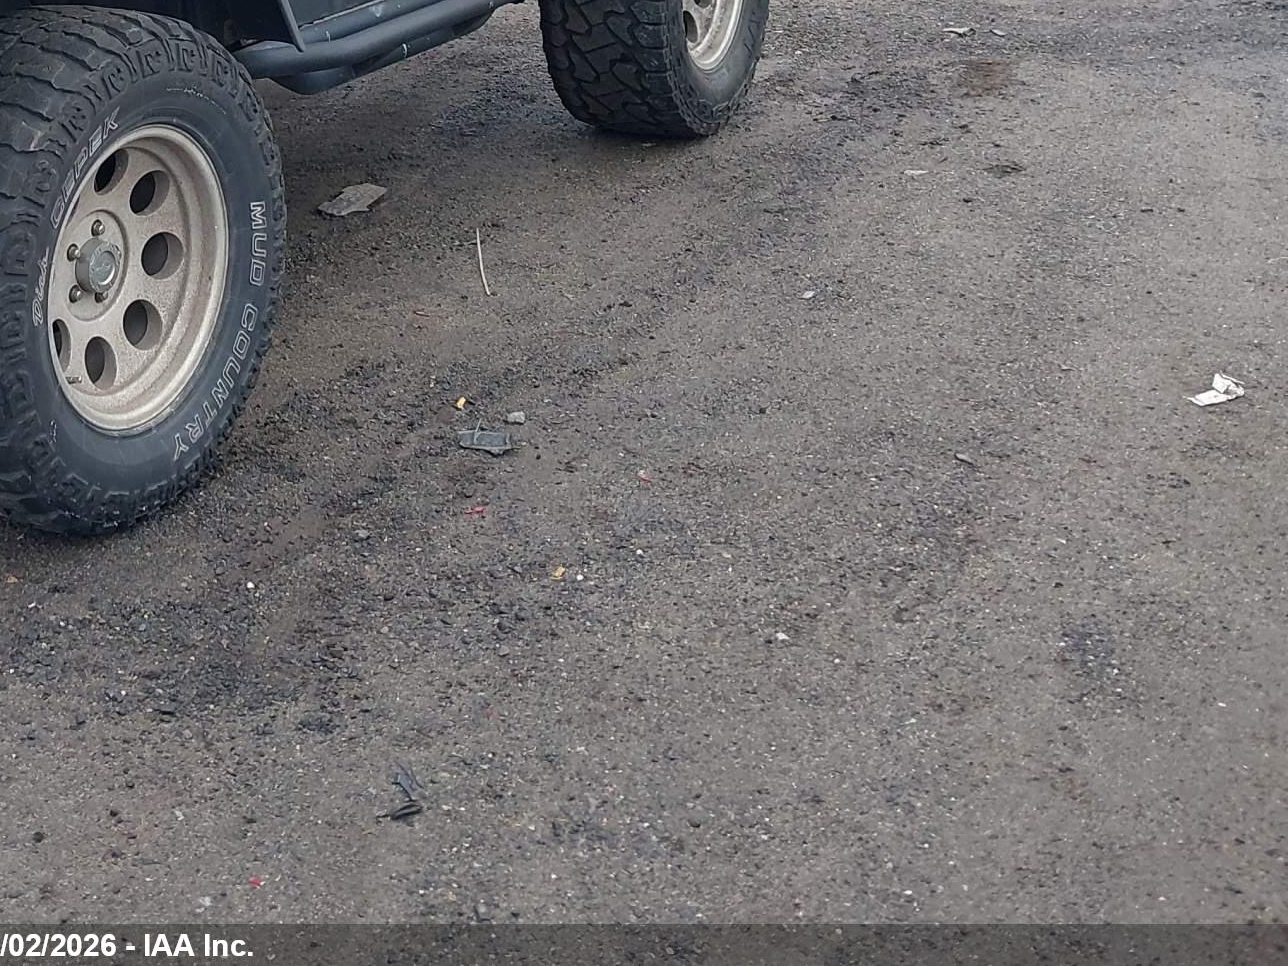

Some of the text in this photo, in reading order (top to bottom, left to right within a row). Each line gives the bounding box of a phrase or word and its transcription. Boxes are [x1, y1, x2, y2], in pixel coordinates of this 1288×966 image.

[51, 106, 121, 229] CEPEK
[173, 201, 268, 462] MUD COUNTRY
